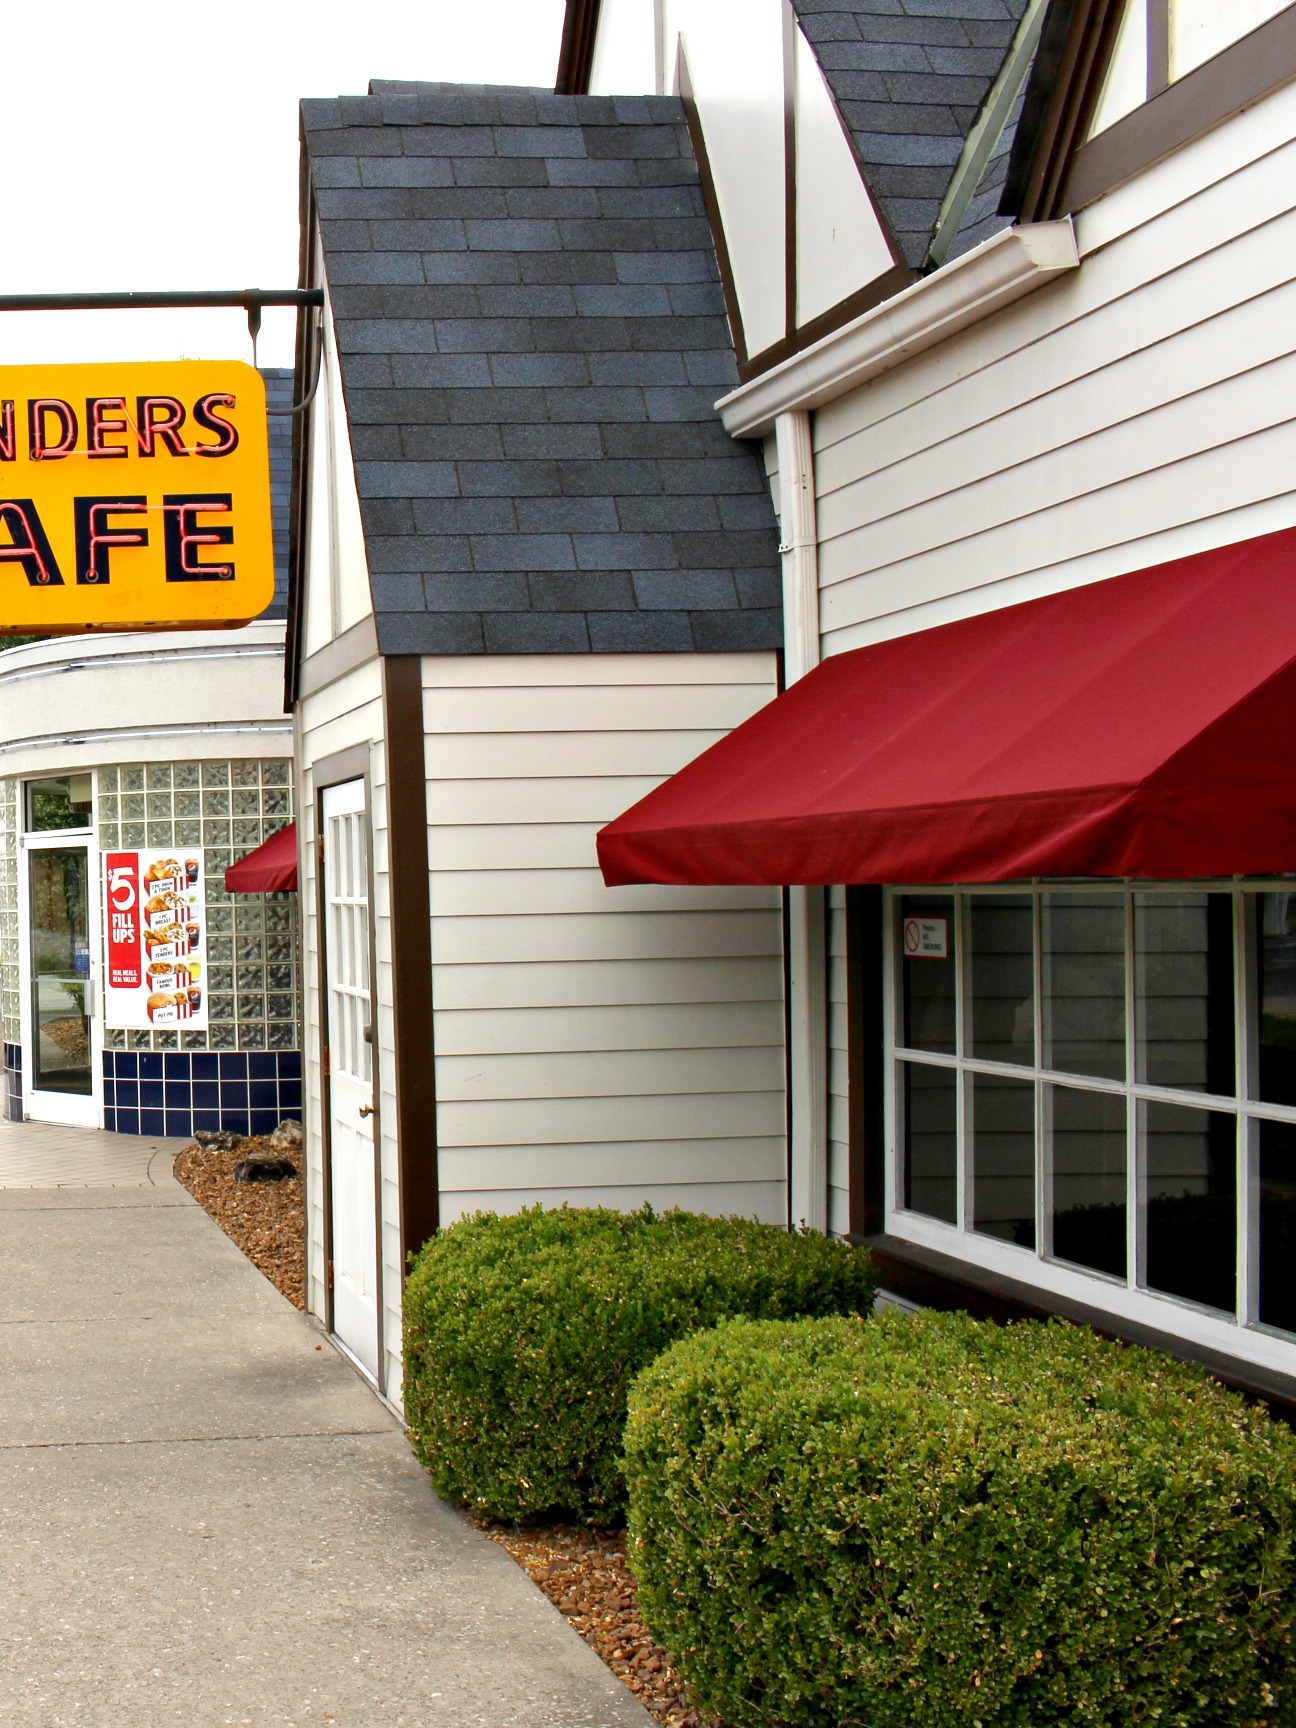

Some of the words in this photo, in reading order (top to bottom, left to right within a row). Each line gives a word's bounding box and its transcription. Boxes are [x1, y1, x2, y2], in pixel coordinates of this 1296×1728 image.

[108, 867, 135, 911] $5
[112, 913, 134, 928] FILL
[113, 929, 135, 943] UPS
